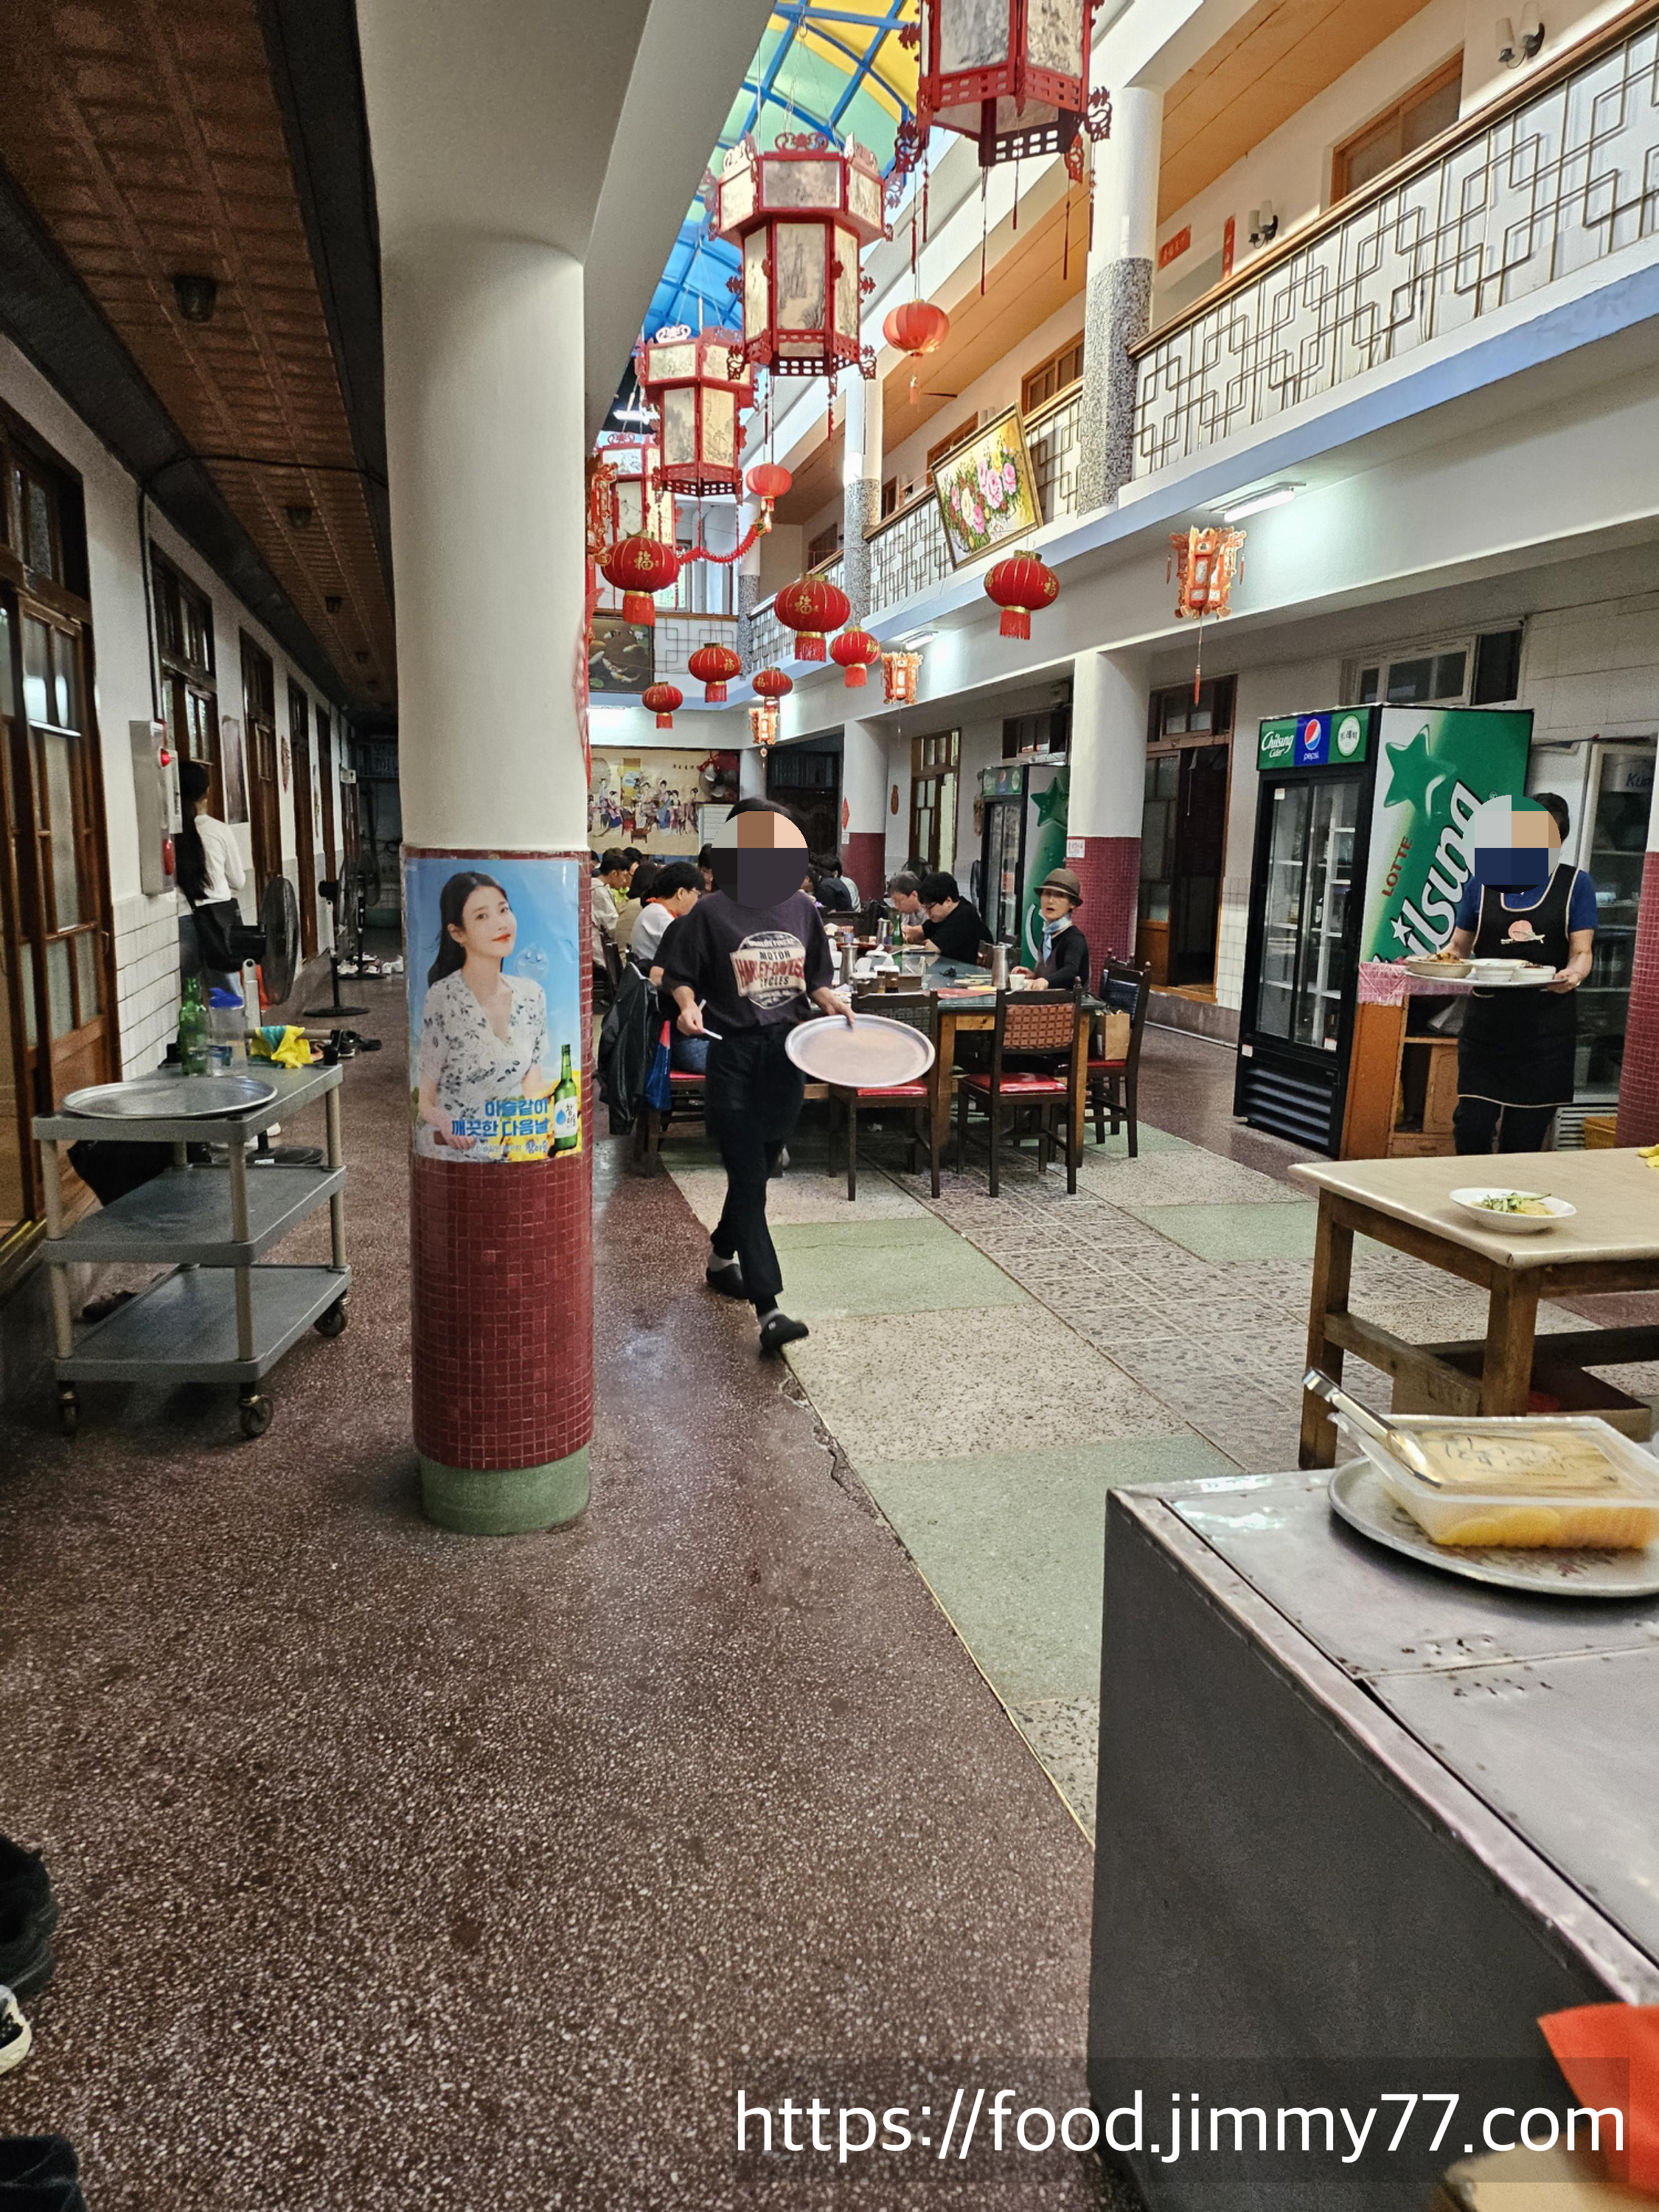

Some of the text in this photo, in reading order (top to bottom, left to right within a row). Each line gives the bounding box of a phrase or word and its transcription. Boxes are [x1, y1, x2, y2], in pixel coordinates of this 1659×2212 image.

[1262, 731, 1295, 754] Chilsung
[1269, 748, 1285, 758] Cider
[1303, 751, 1320, 761] pepsi
[1382, 835, 1412, 897] LOTTE
[484, 1097, 549, 1117] 이슬같이
[451, 1117, 549, 1137] 깨끗한 다음날
